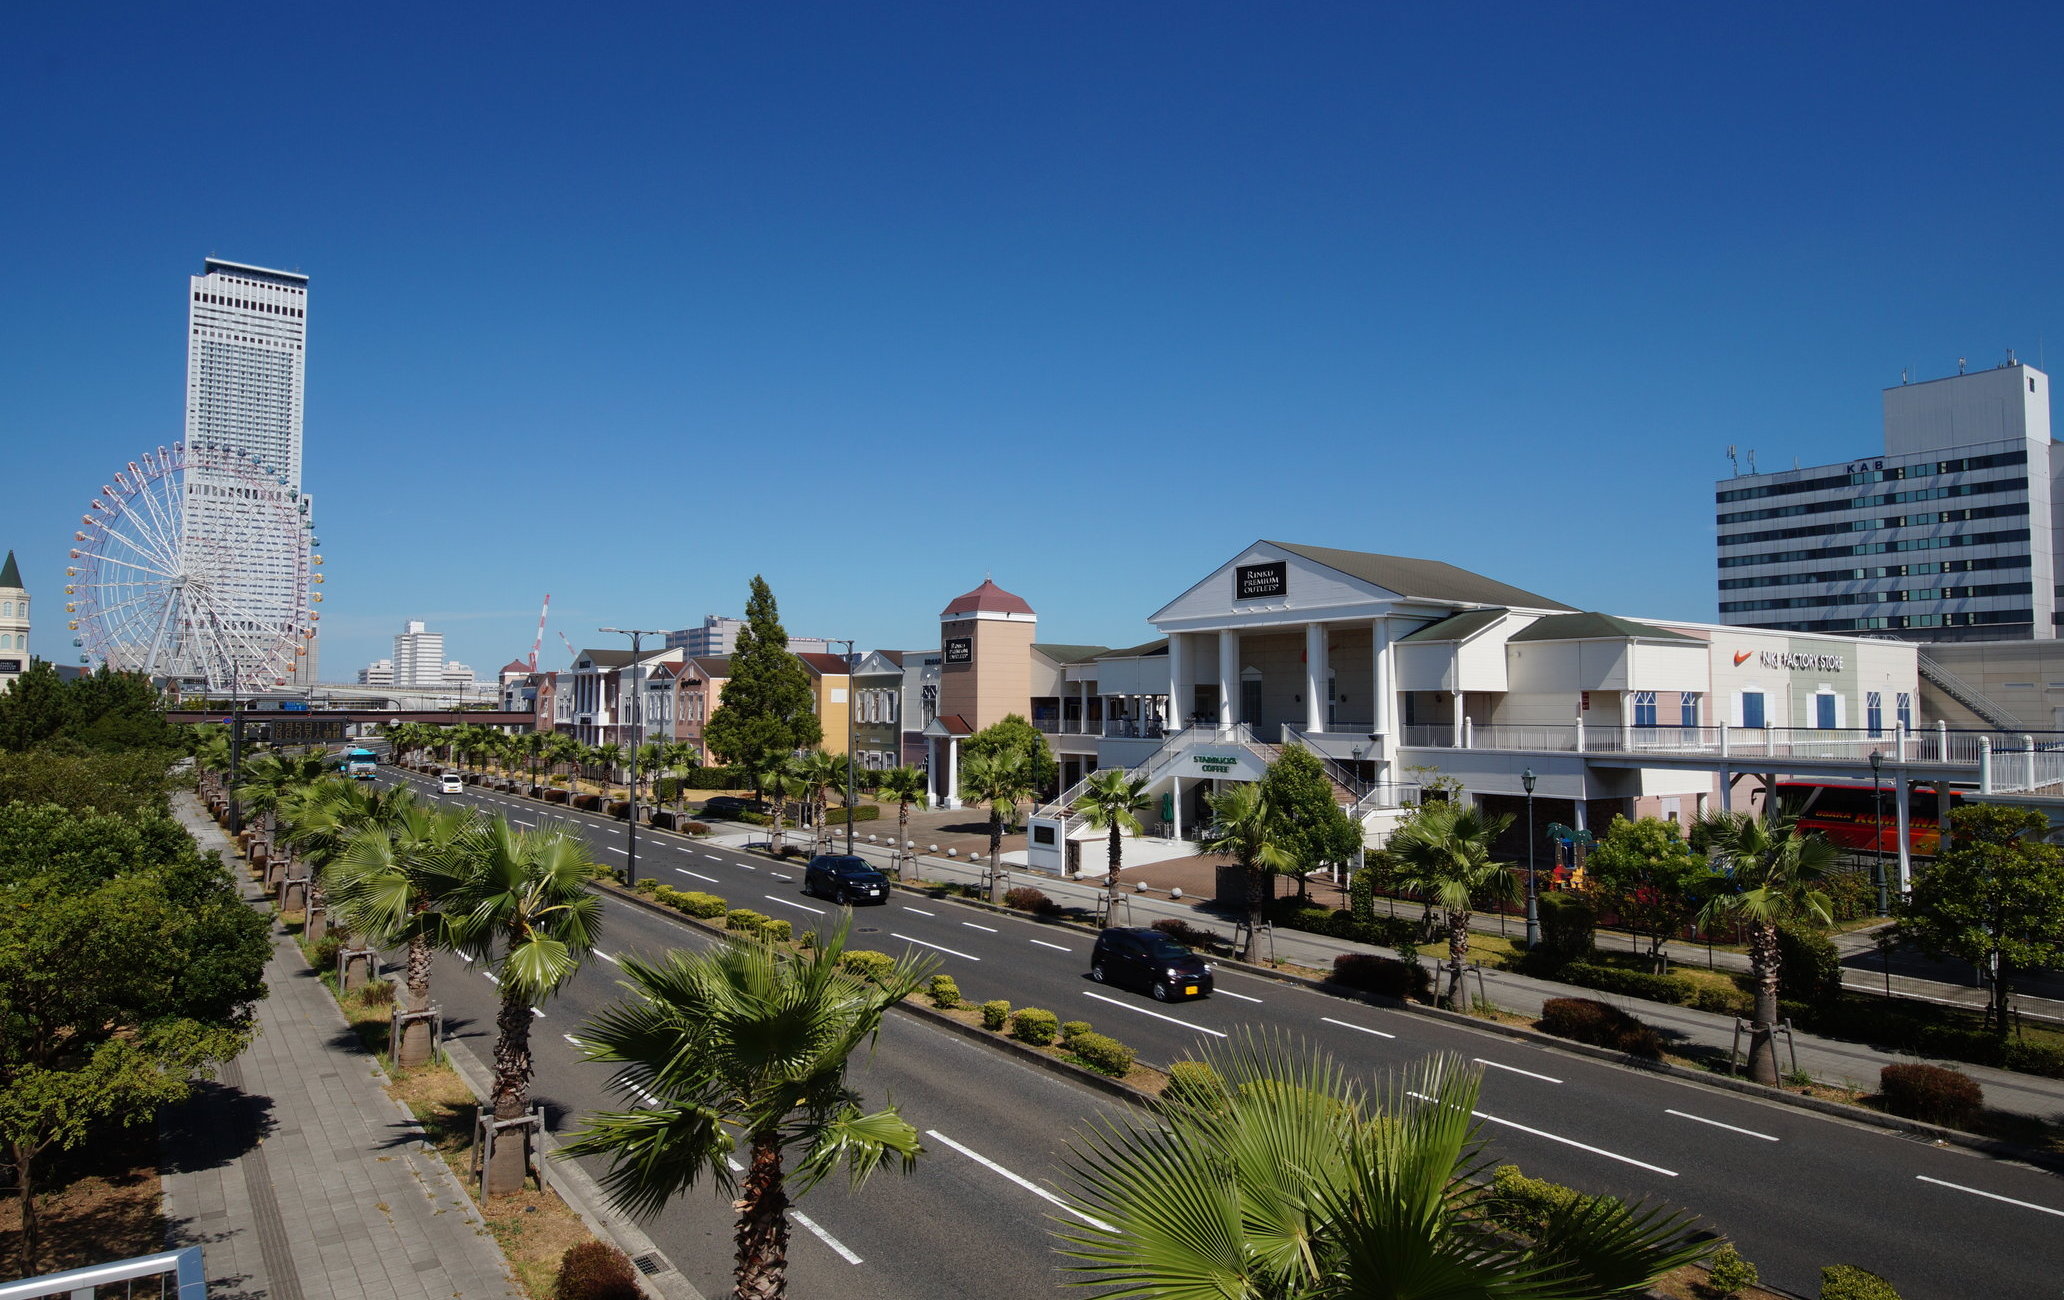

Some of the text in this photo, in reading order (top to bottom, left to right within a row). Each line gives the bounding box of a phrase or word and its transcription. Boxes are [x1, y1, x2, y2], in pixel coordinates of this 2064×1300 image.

[1846, 460, 1884, 474] KAB
[1247, 570, 1274, 580] RINKU
[1243, 576, 1279, 587] PREMIUM
[1784, 651, 1819, 668] FACTORY
[1820, 654, 1844, 669] STORE
[1193, 756, 1237, 765] STARBUCKS
[1201, 764, 1230, 773] COFFEE
